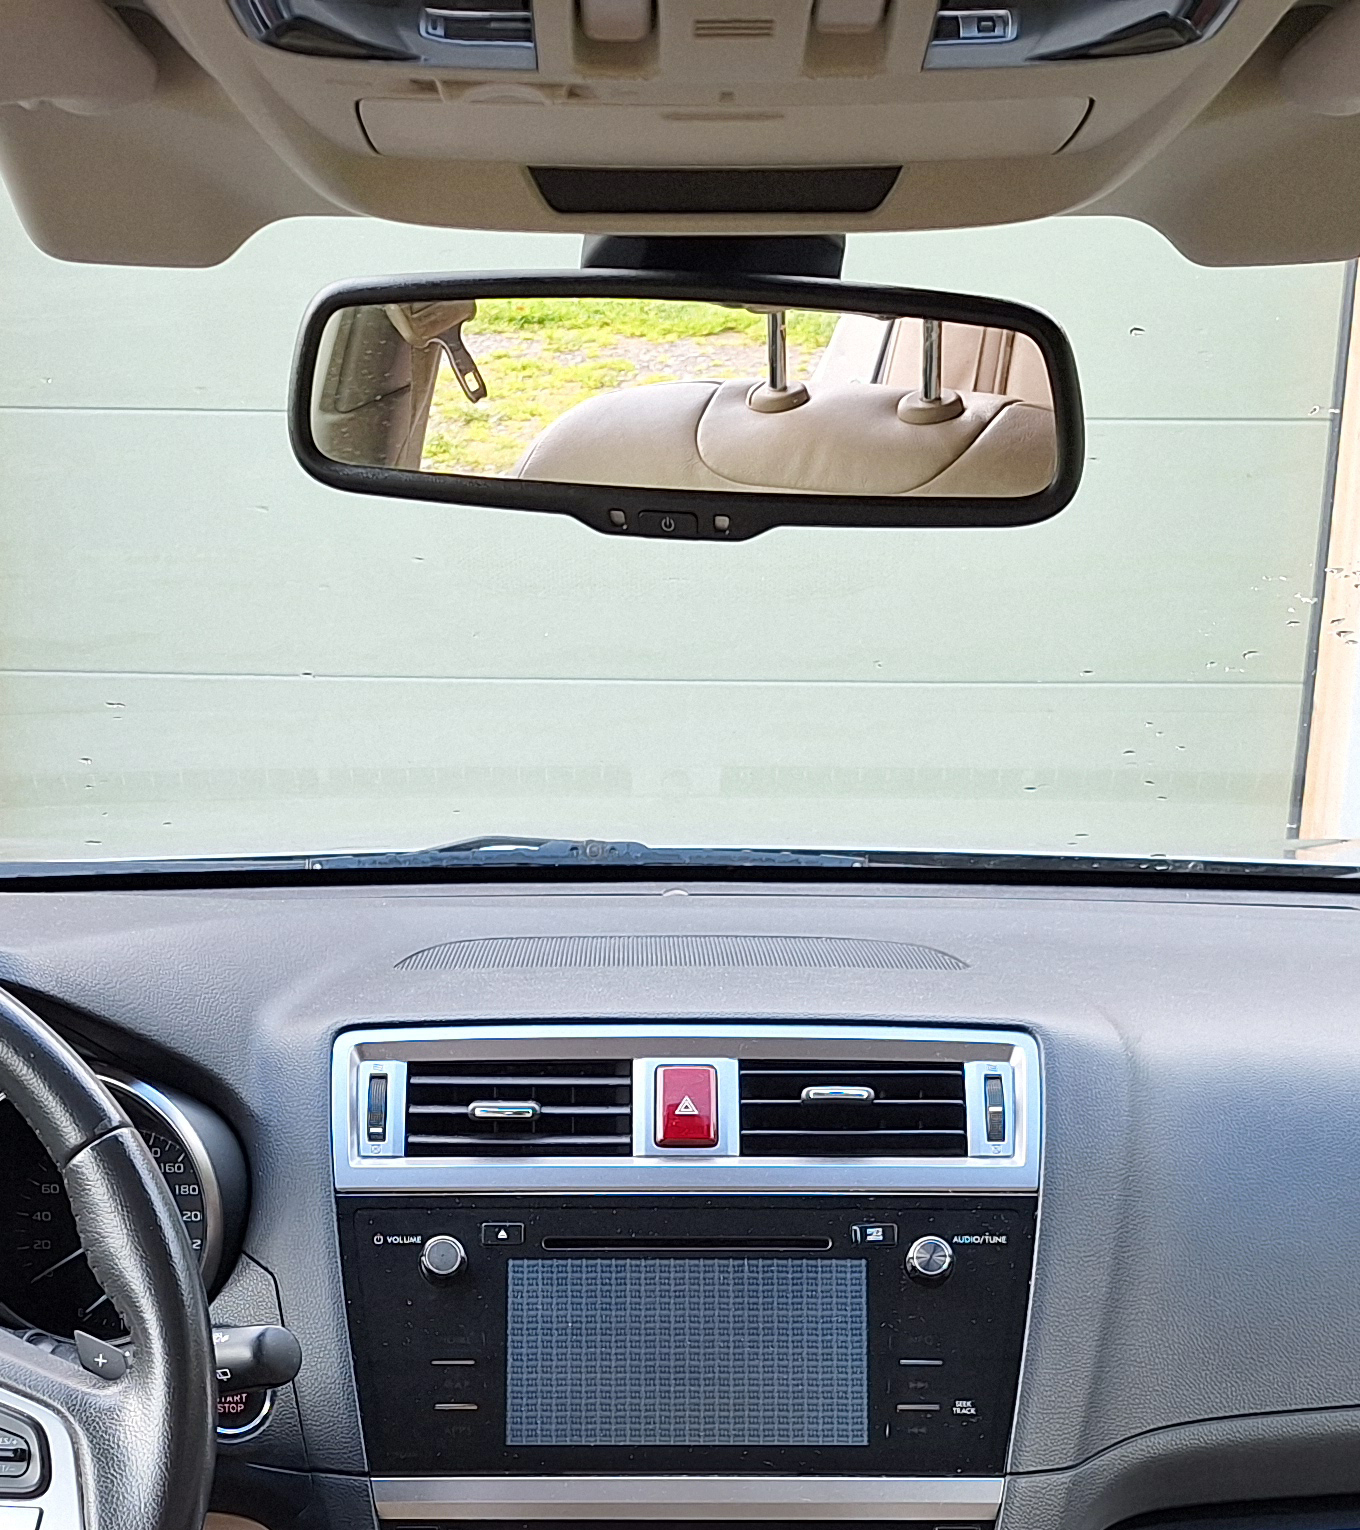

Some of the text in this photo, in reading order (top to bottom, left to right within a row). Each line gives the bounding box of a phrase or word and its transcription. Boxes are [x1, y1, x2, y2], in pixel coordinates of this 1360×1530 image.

[160, 1163, 184, 1173] 160
[41, 1183, 60, 1194] 60
[174, 1184, 199, 1195] 180
[32, 1211, 52, 1222] 40
[33, 1239, 51, 1250] 20
[386, 1235, 422, 1244] VOLUME
[952, 1235, 1008, 1244] AUDIO/TUNE
[217, 1403, 245, 1413] STOP
[952, 1407, 977, 1415] TRACK
